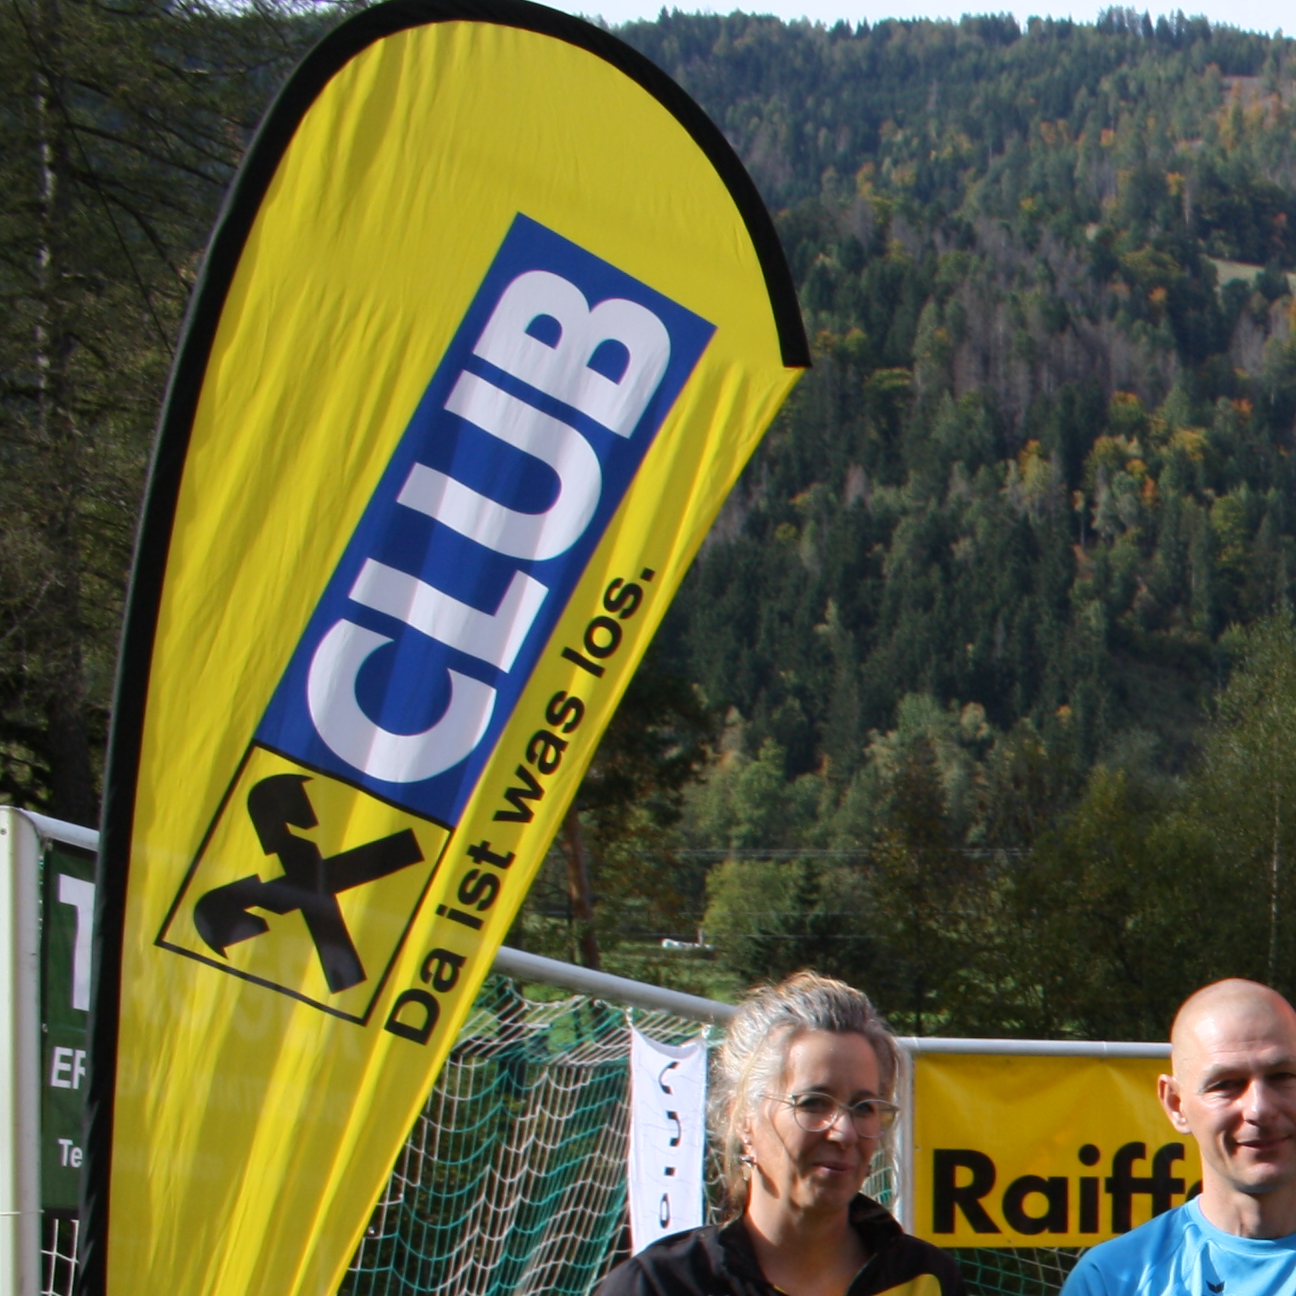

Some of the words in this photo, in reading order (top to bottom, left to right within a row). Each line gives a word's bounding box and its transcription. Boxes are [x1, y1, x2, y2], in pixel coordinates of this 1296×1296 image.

[307, 269, 672, 784] CLUB
[383, 947, 467, 1046] Da
[435, 840, 516, 930] ist
[492, 690, 586, 824] was
[561, 567, 656, 679] los.
